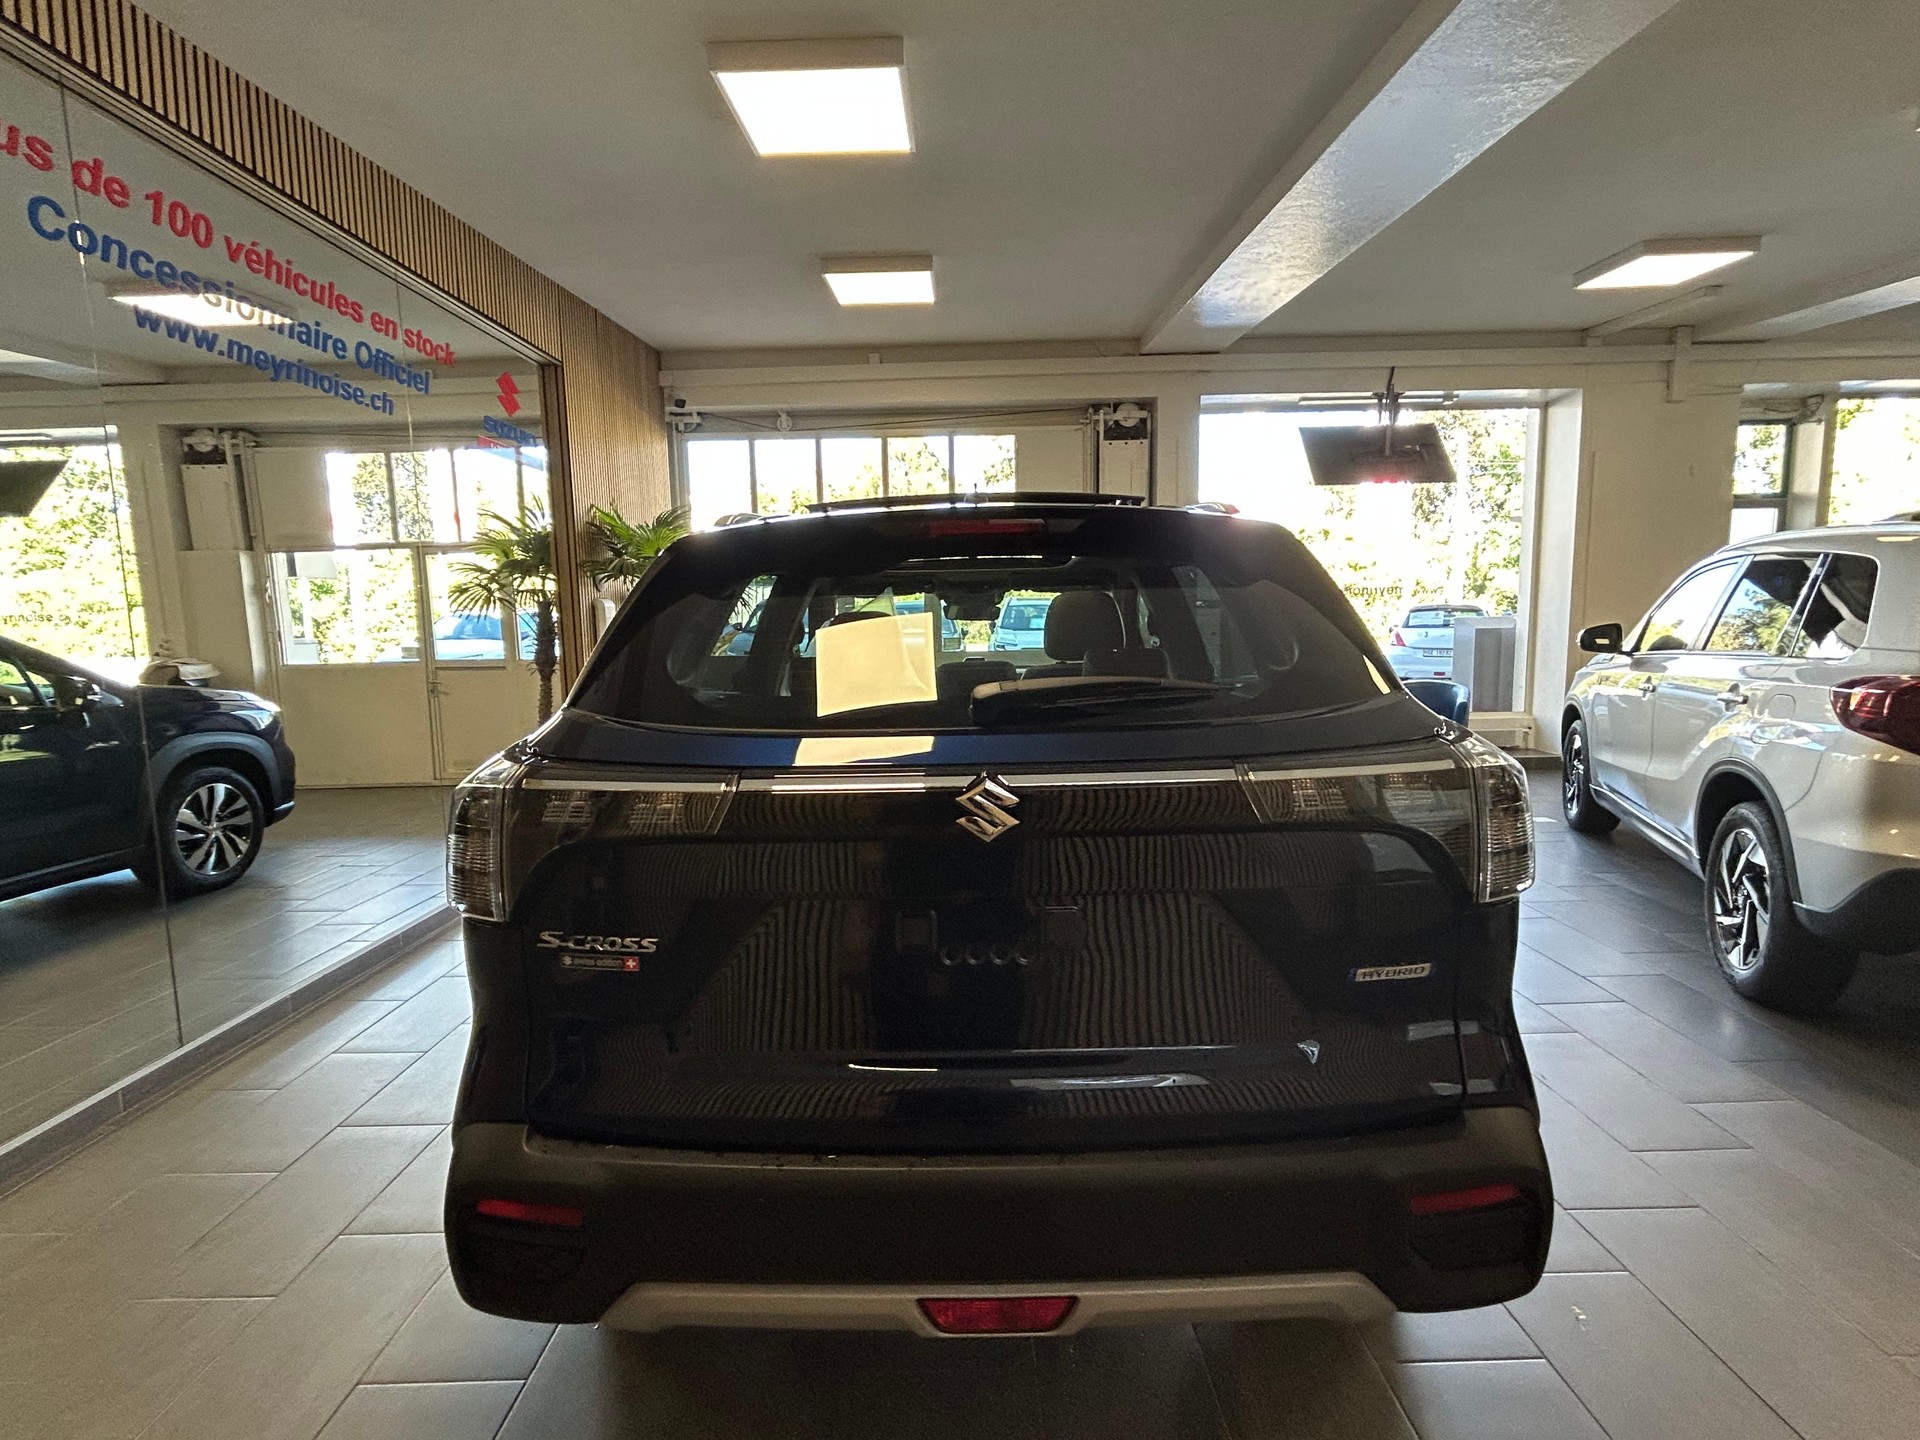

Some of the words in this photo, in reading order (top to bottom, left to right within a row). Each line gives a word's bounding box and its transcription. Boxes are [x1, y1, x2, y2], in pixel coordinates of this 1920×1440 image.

[27, 195, 347, 360] Concessionnaire
[354, 340, 431, 395] Officiel
[71, 157, 130, 209] de
[145, 190, 214, 249] 100
[223, 234, 364, 323] véhicules
[370, 311, 398, 340] en
[403, 327, 456, 368] stock
[134, 303, 394, 416] www.meyrinoise.ch
[1361, 965, 1426, 980] HYBRID
